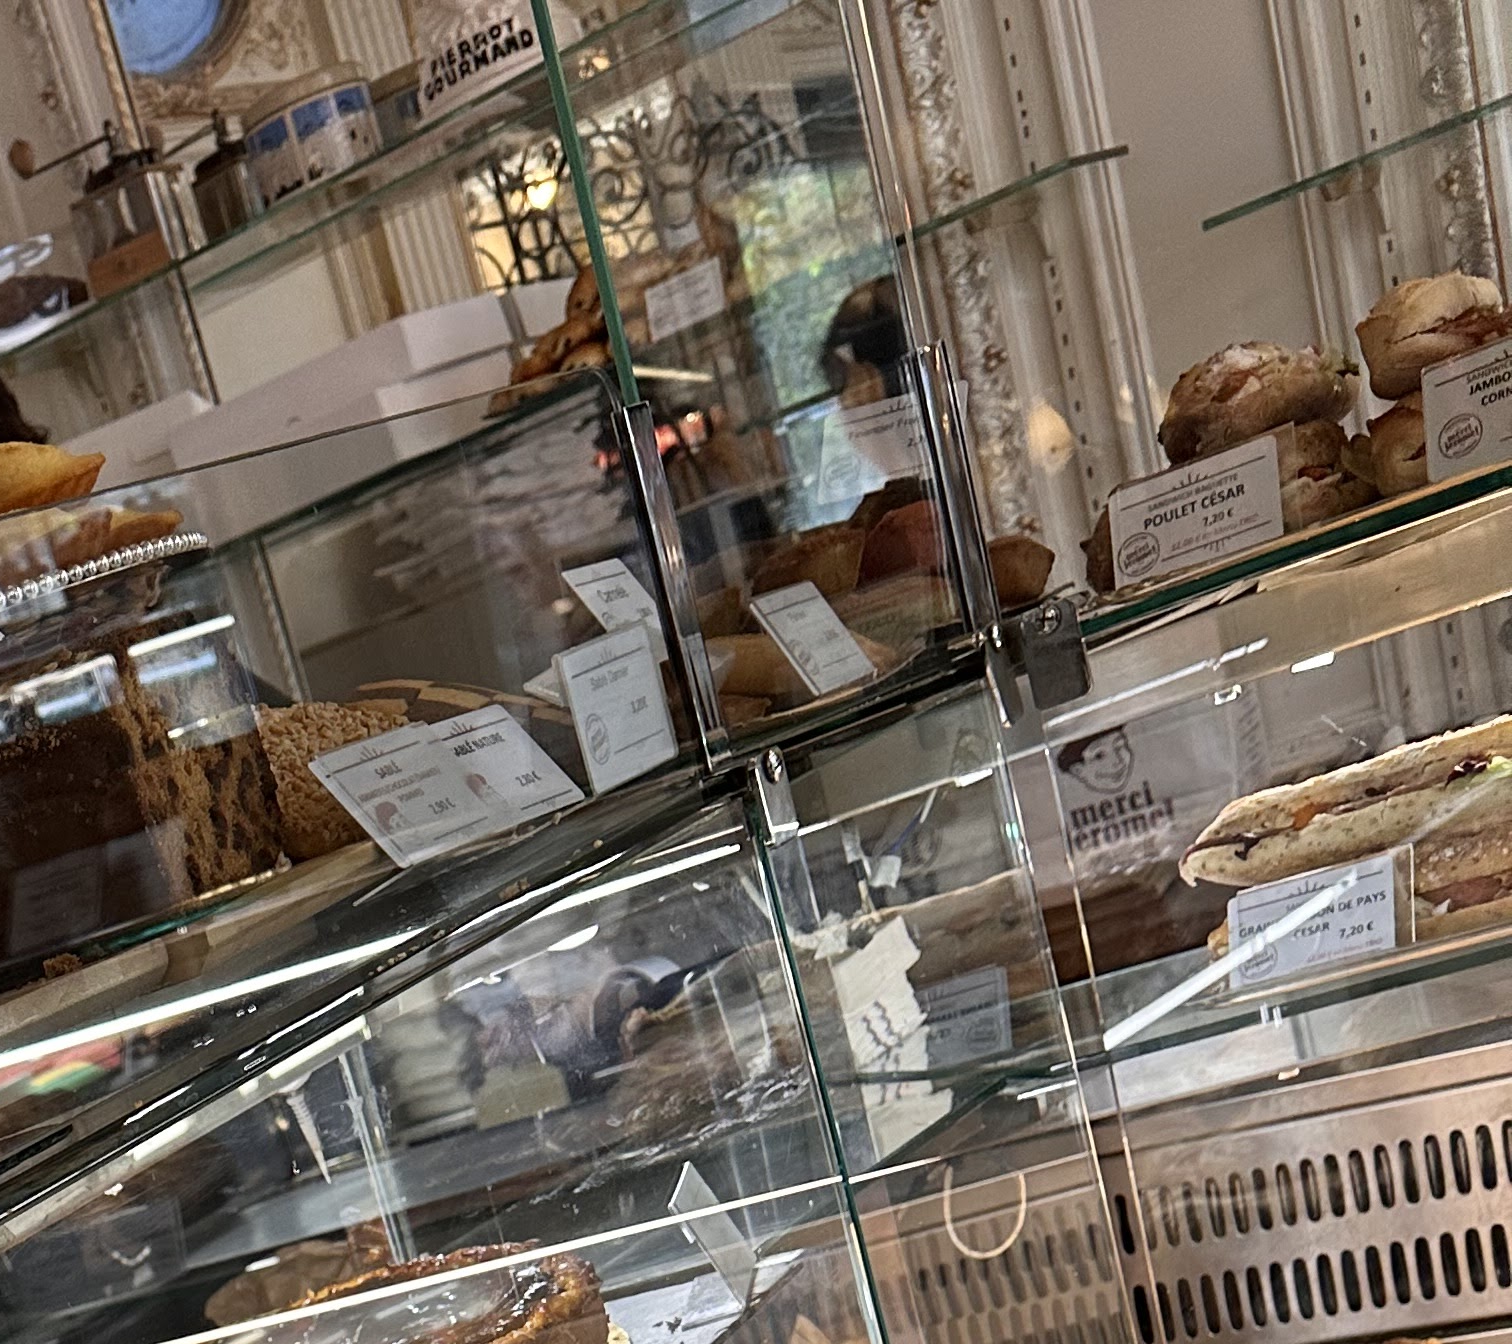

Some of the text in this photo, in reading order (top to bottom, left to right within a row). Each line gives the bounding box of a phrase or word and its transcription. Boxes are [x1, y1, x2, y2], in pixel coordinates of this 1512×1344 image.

[430, 17, 514, 74] PIERROT
[423, 29, 534, 101] GOURMAND
[1469, 371, 1512, 395] JAMBO
[1143, 484, 1245, 531] POULET CÉSAR
[1202, 508, 1235, 527] 7,20 €
[1070, 781, 1154, 830] merci
[1338, 900, 1353, 912] DE
[1356, 890, 1387, 907] PAYS
[1339, 921, 1374, 939] 7,20 €
